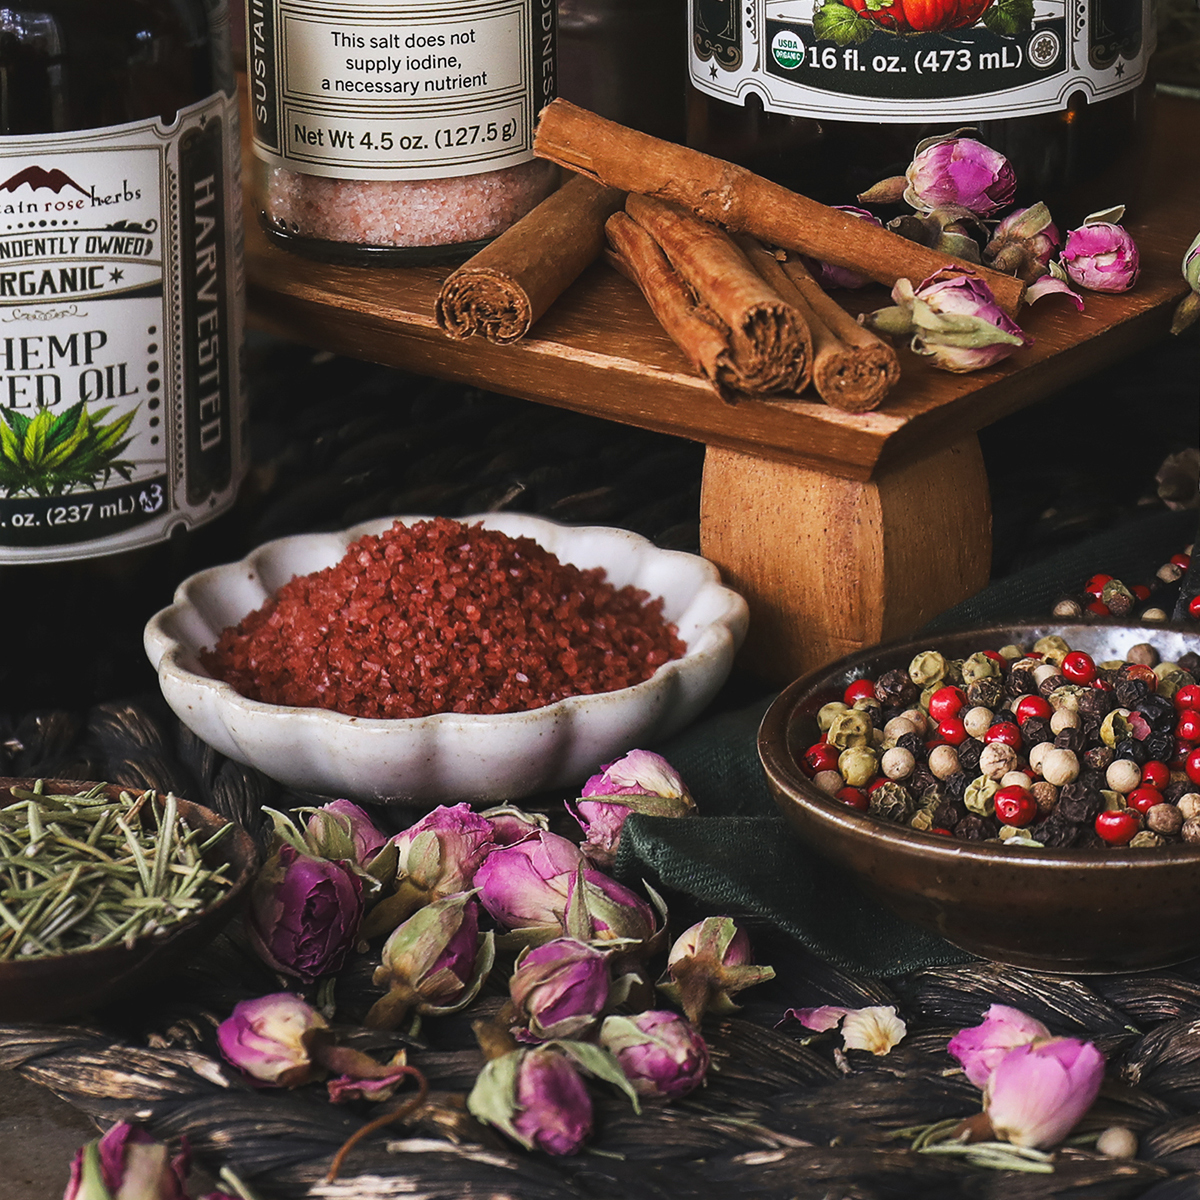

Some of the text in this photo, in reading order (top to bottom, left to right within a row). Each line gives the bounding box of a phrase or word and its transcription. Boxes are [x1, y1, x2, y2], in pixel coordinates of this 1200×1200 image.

[331, 29, 476, 49] This salt does not
[778, 39, 798, 49] USDA
[346, 54, 462, 74] supply iodine,
[808, 45, 1023, 75] 16 fl. oz. (473 mL)
[321, 71, 487, 96] a necessary nutrient
[294, 118, 517, 151] Net Wt 4.5 oz. (127.5 g)
[45, 199, 84, 211] rose
[91, 180, 141, 207] herbs
[0, 236, 145, 259] NDENTLY OWNED
[0, 265, 104, 297] RGANIC
[194, 173, 222, 451] HARVESTED
[0, 363, 138, 408] ED OIL
[11, 495, 135, 527] oz. (237 mL)
